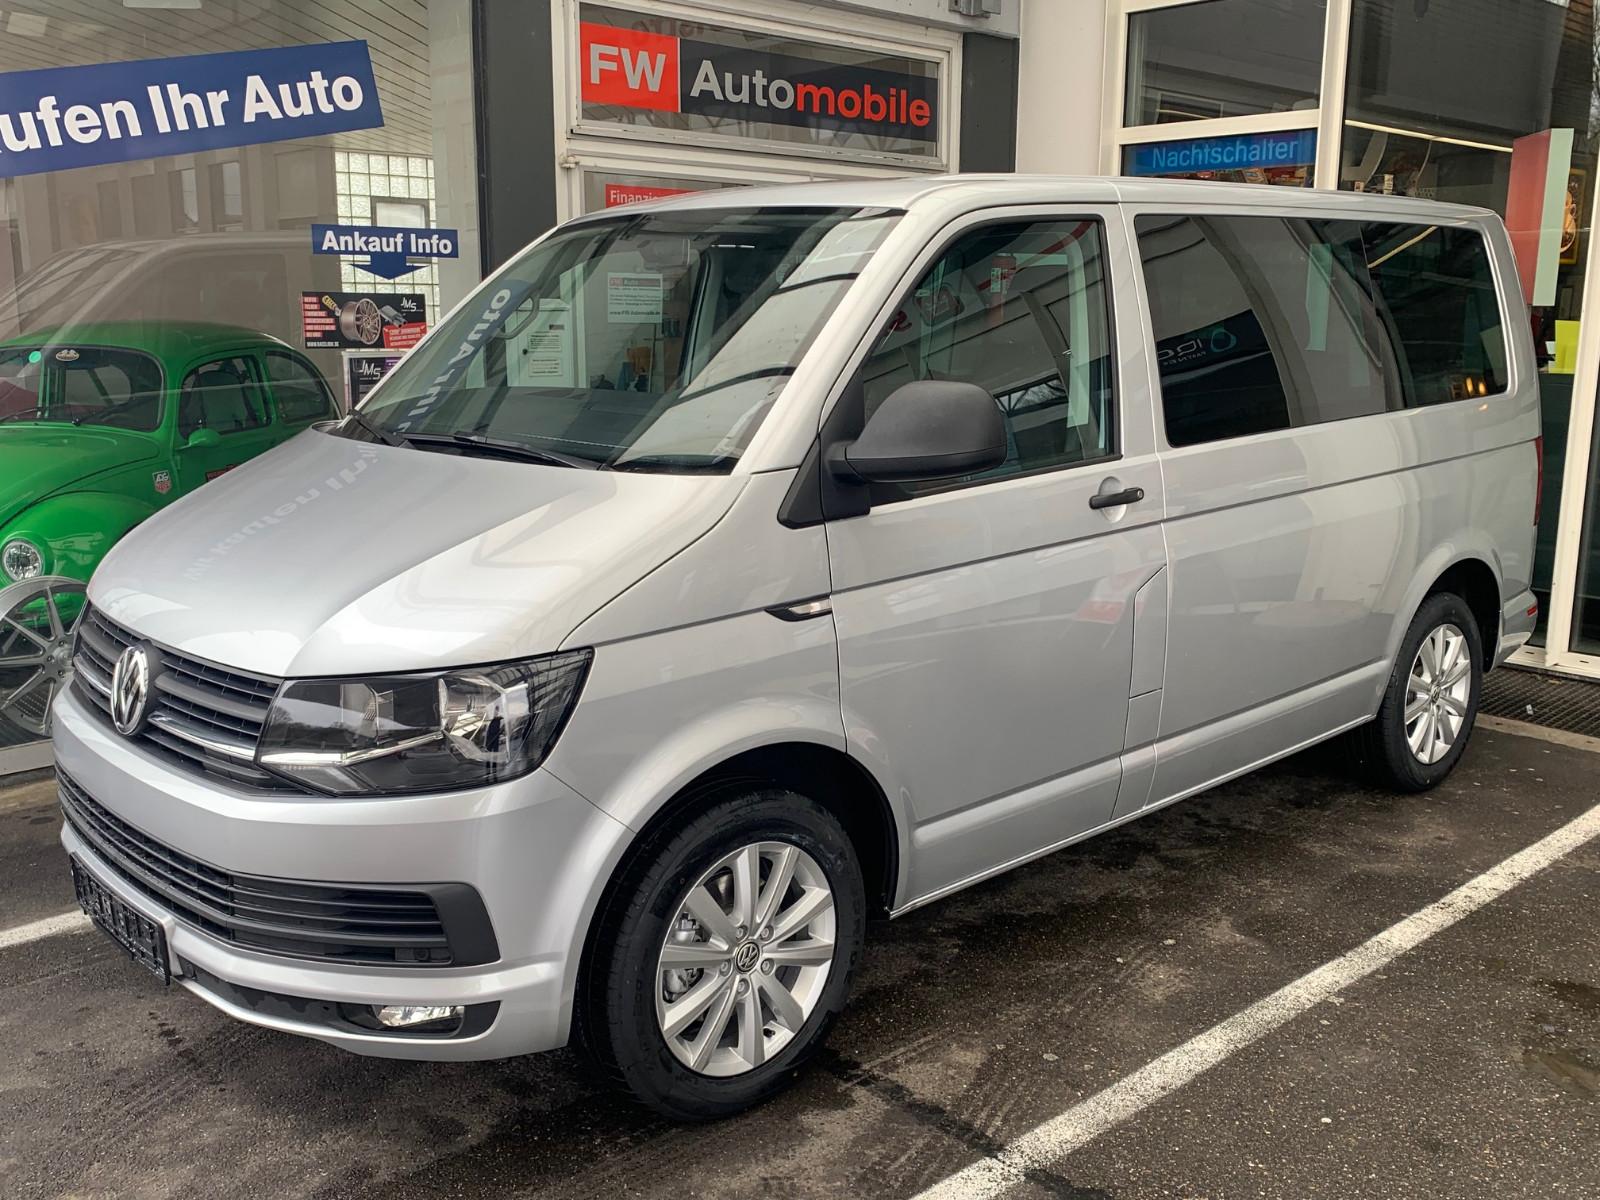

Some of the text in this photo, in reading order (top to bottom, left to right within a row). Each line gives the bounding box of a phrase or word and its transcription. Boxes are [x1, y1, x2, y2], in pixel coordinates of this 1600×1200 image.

[588, 42, 932, 127] FW Automobile
[0, 69, 364, 153] ufen Ihr Auto
[1151, 136, 1300, 169] Nachtschalter
[609, 189, 657, 204] Finanzi
[321, 230, 453, 254] Ankauf Info
[400, 296, 417, 312] JMS
[358, 359, 382, 380] JMS
